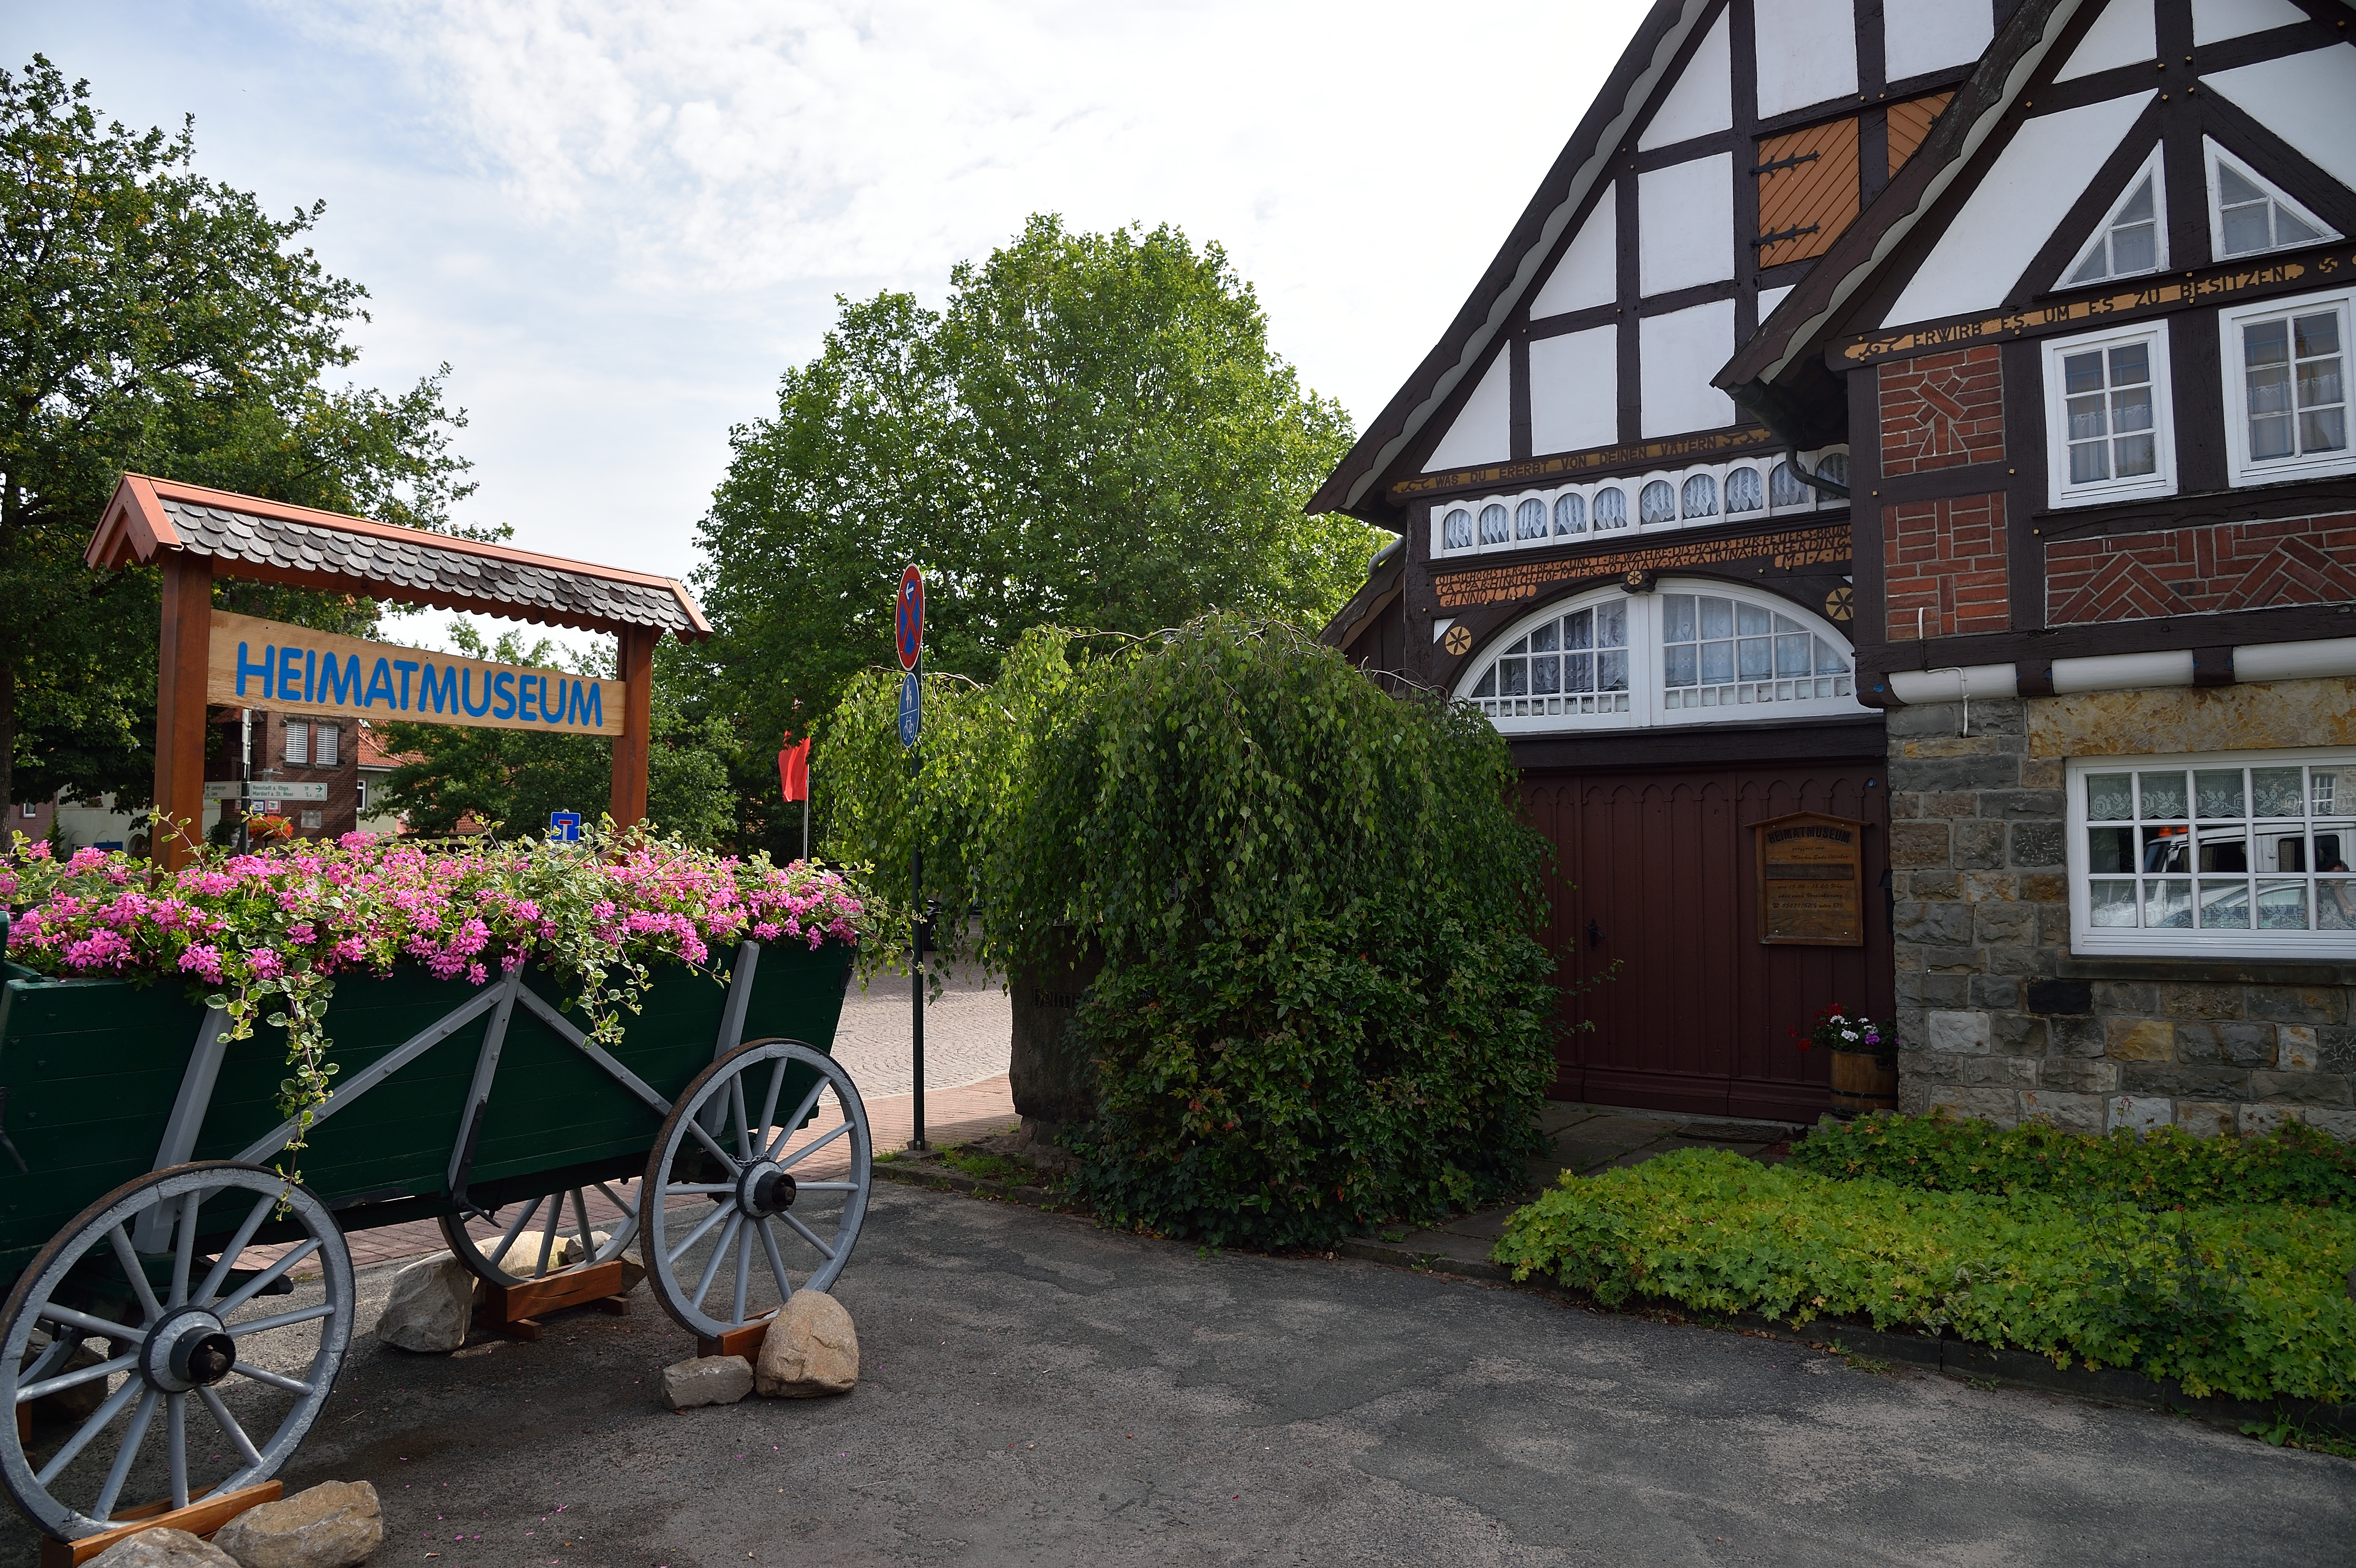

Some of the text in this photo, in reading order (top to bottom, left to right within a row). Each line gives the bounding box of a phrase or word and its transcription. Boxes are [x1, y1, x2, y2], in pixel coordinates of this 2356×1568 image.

[1914, 324, 1982, 346] ERWIRB
[2043, 305, 2069, 322] UM
[2089, 299, 2114, 314] ES
[2135, 289, 2160, 305] ZU
[1436, 475, 1458, 488] WAS
[1470, 470, 1486, 483] DU
[1499, 462, 1549, 478] ERERBT
[1560, 456, 1587, 470] VON
[1600, 447, 1647, 464] DEINEN
[236, 642, 603, 728] HEIMATMUSEUM
[1769, 827, 1851, 844] HEIMATMUSEUM
